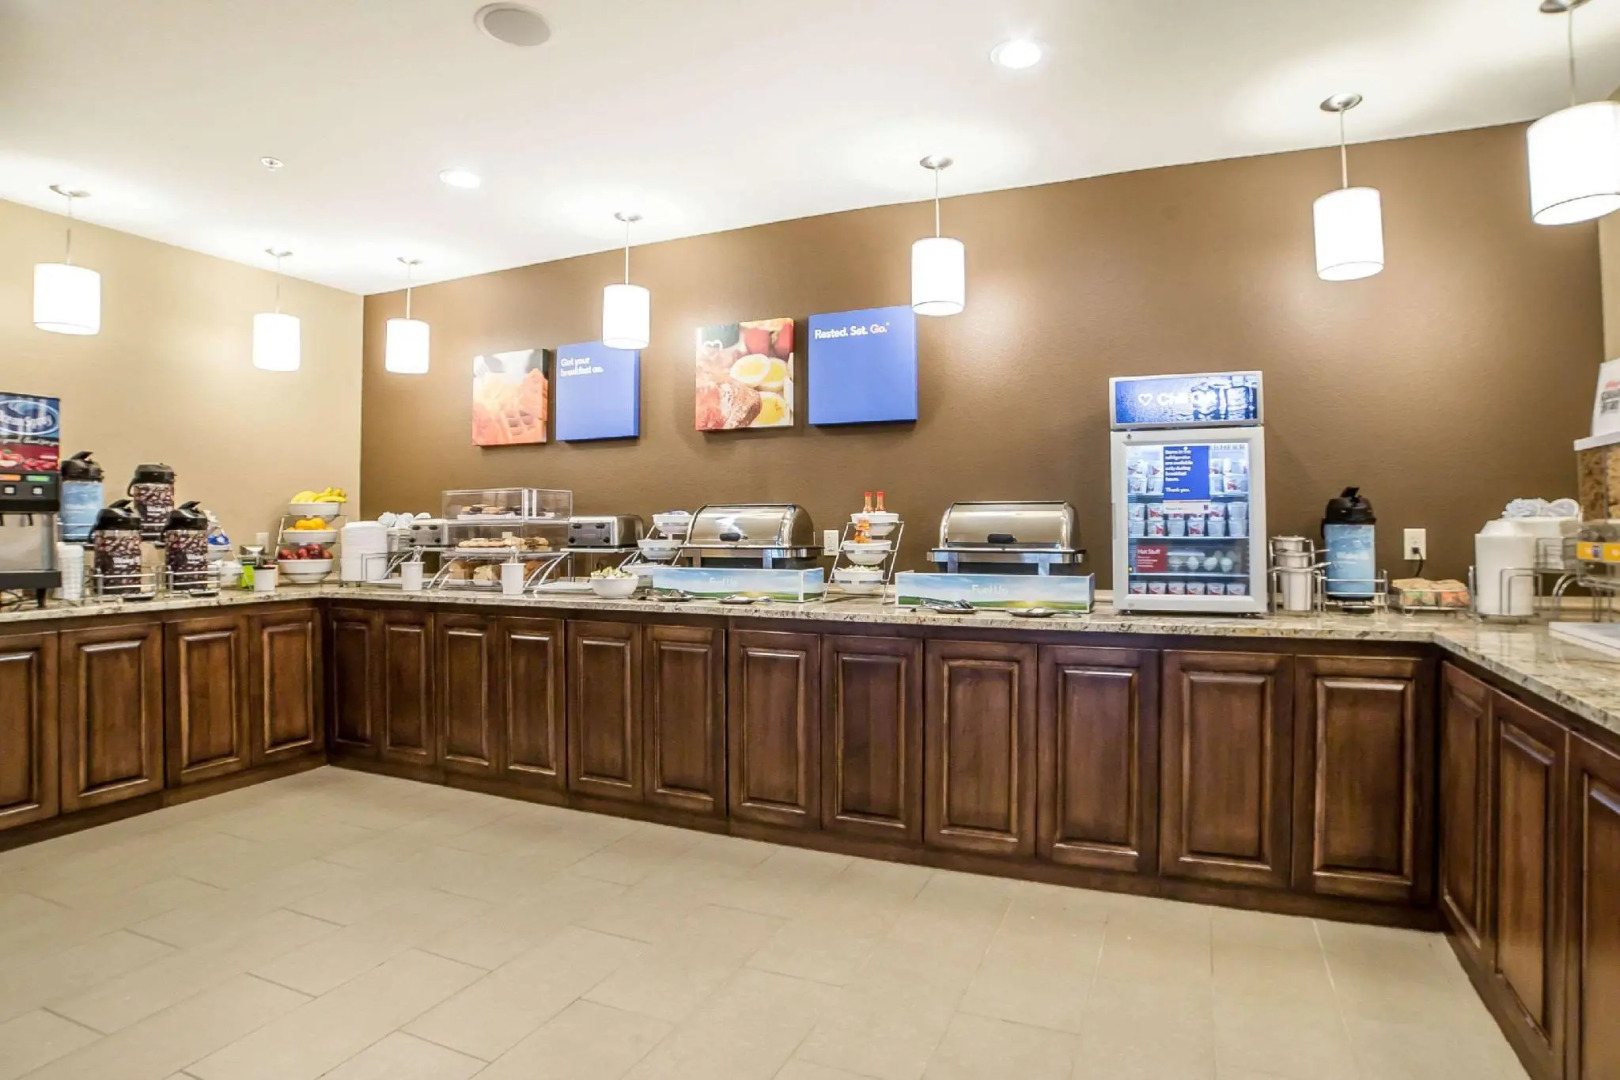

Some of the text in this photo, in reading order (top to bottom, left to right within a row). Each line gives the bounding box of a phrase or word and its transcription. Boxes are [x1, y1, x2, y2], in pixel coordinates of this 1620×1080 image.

[814, 327, 849, 340] Rested.
[850, 325, 869, 336] Set.
[561, 357, 591, 368] Get your
[560, 366, 592, 377] breakfast
[971, 583, 1009, 597] Fuel Up
